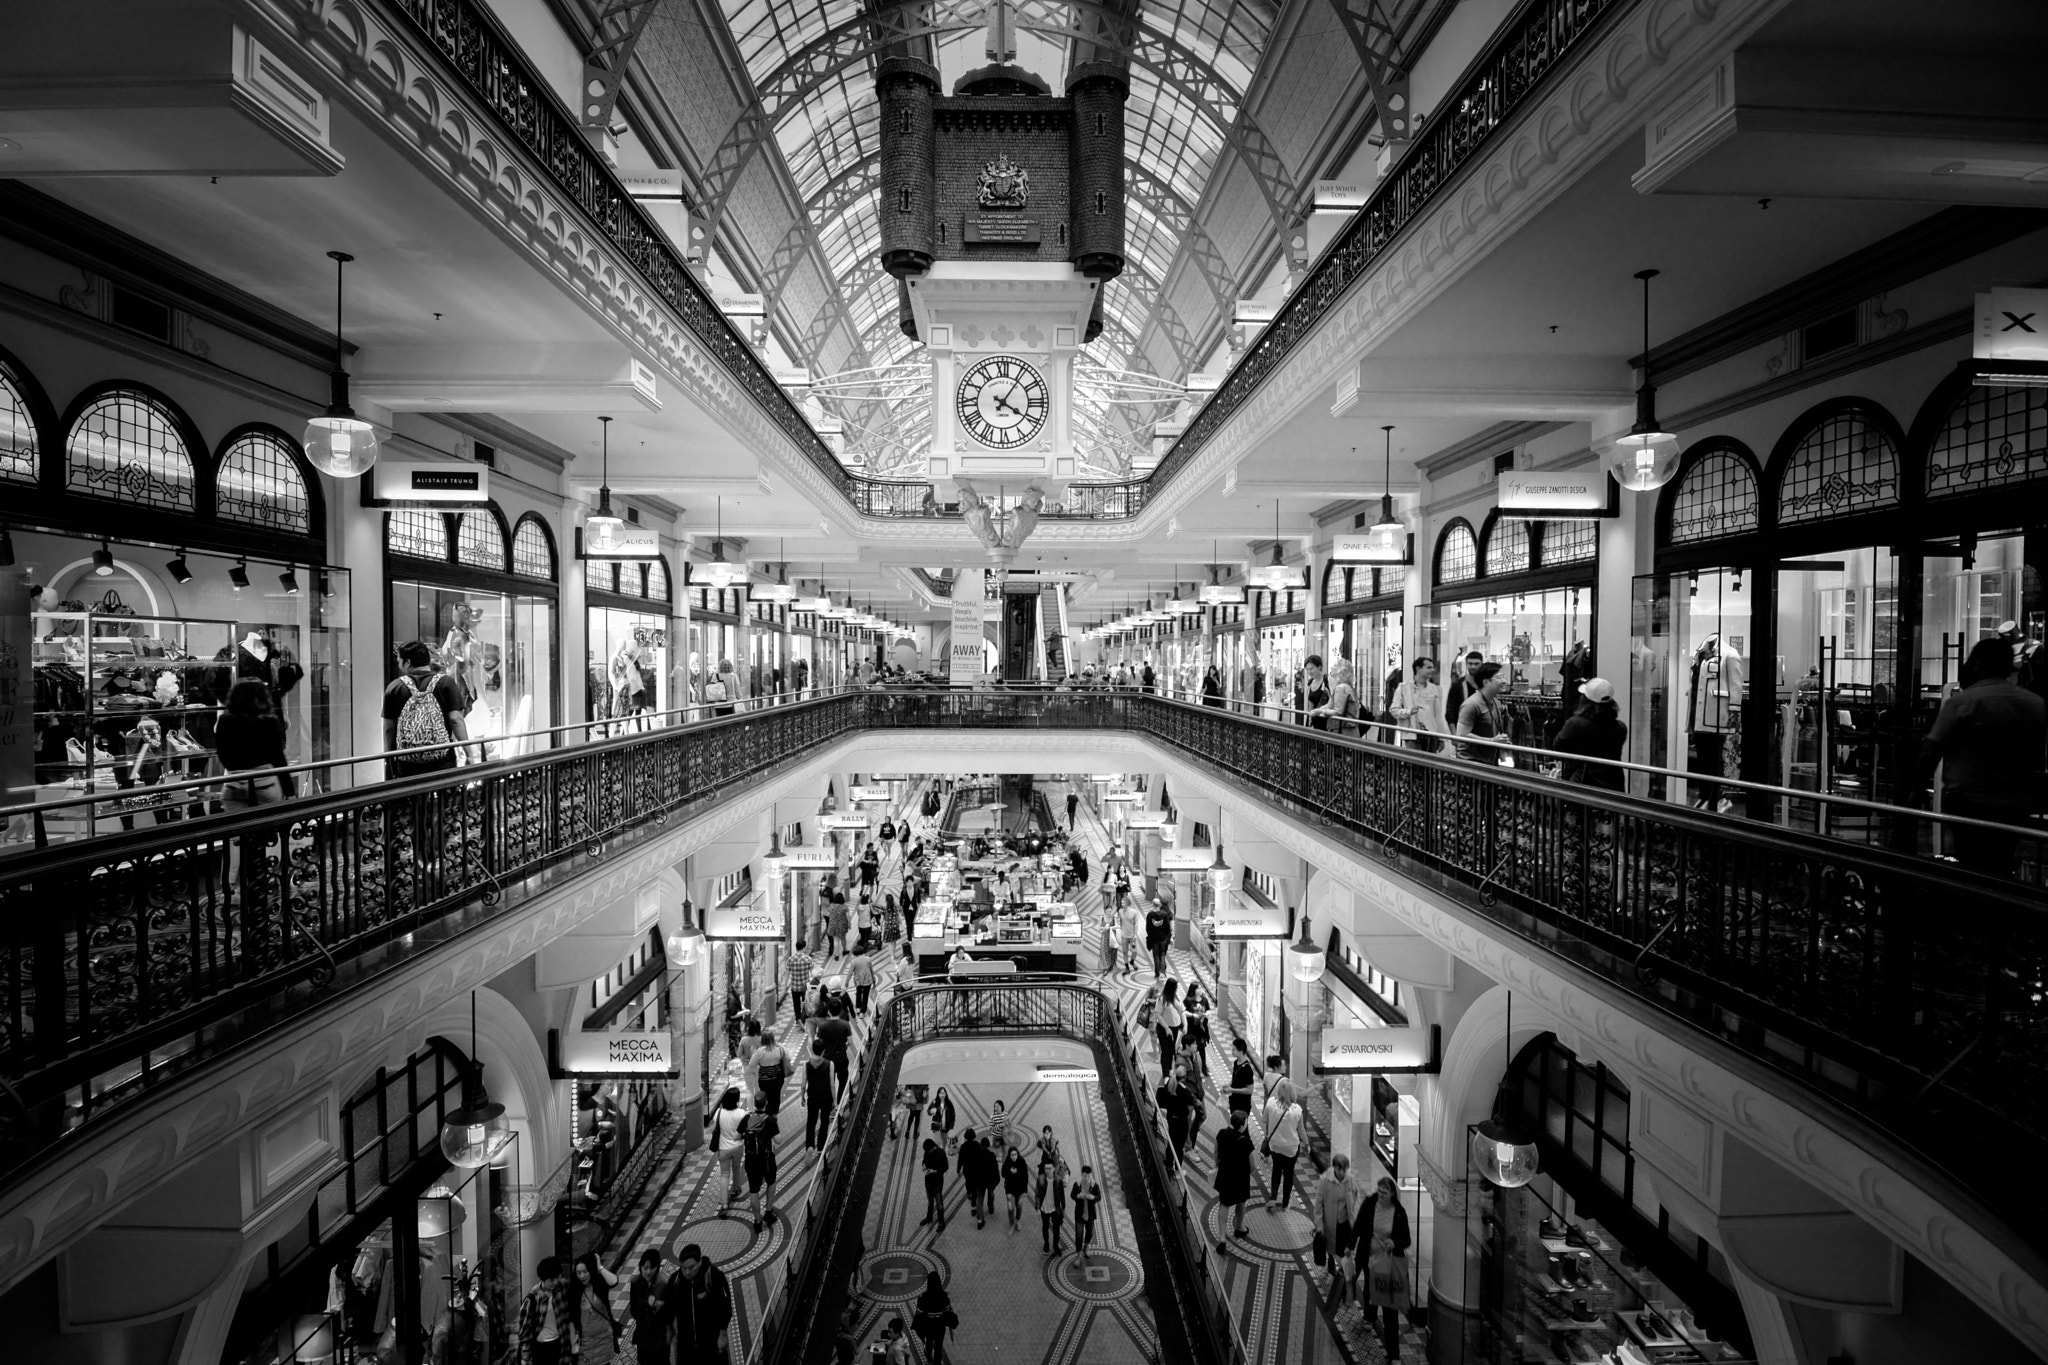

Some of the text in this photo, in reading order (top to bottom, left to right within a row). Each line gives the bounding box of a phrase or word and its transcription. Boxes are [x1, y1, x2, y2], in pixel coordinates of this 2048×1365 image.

[1525, 486, 1587, 494] GIUSEPPE ZANOTTI DESIGN
[952, 644, 981, 656] AWAY
[797, 853, 832, 862] FURLA
[739, 916, 773, 924] MECCA
[609, 1039, 659, 1051] MECCA
[1341, 1044, 1393, 1054] SWAROVSKI
[609, 1052, 664, 1063] MAXIMA
